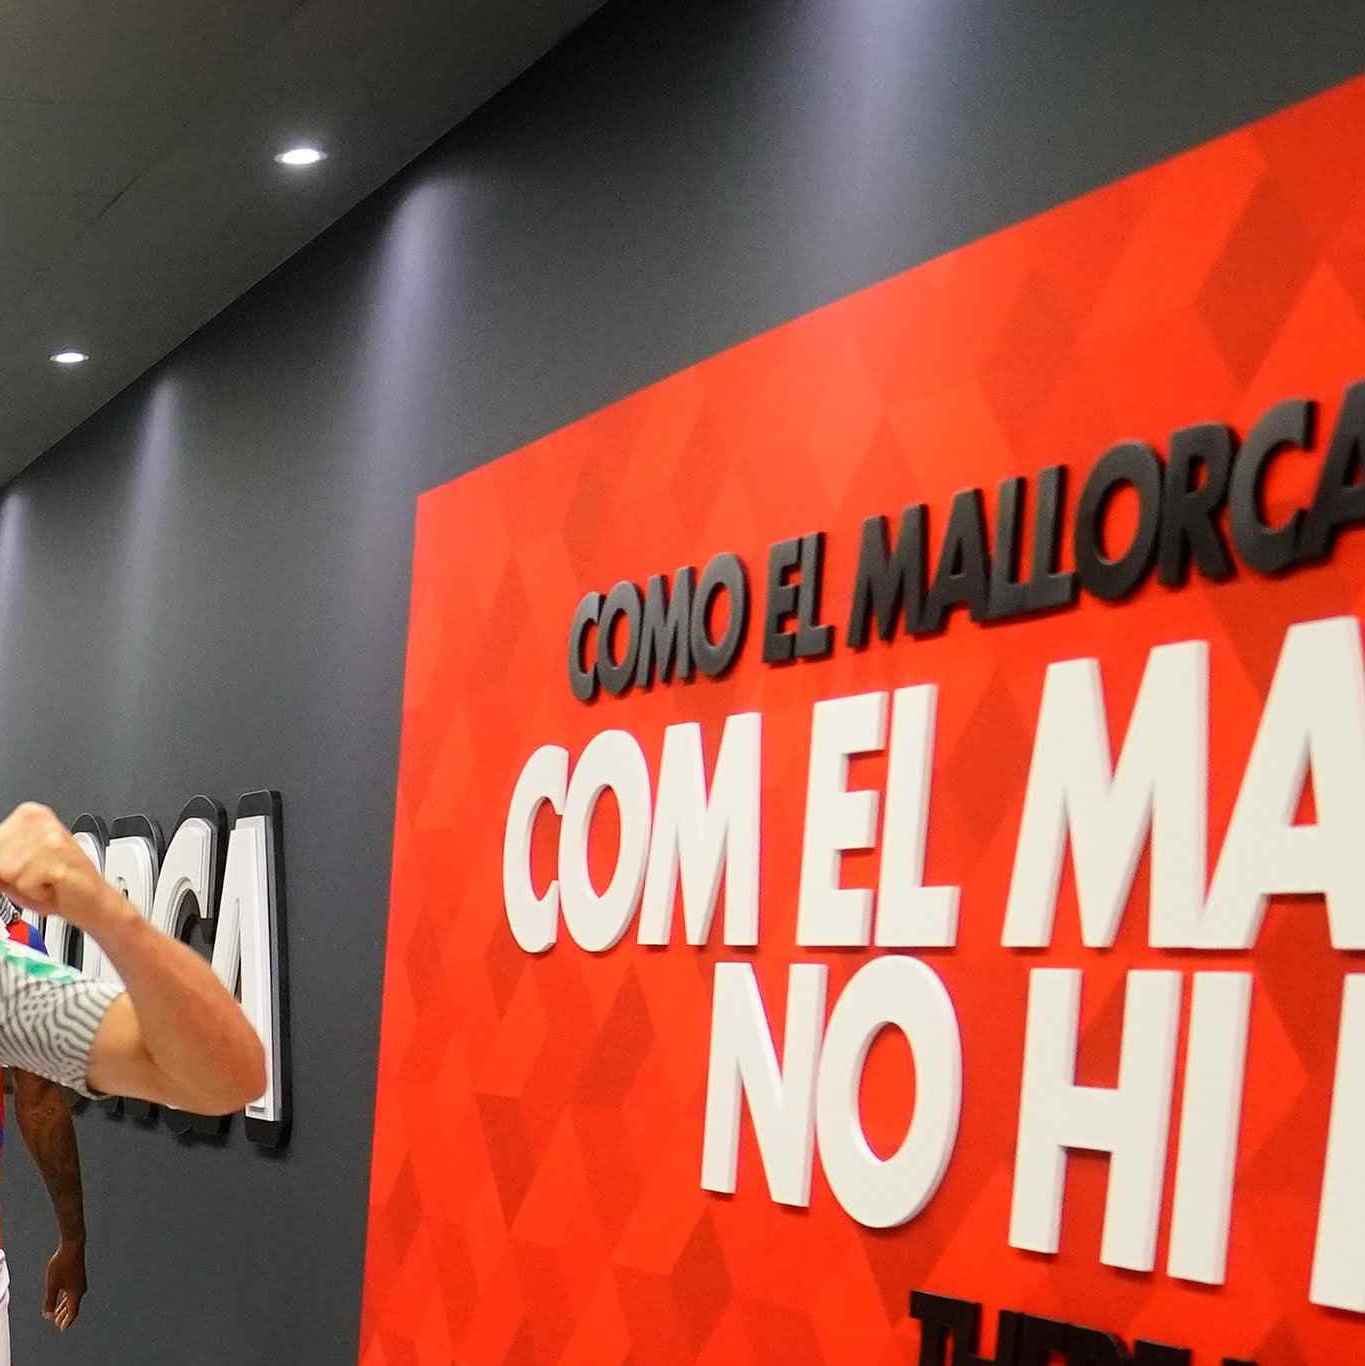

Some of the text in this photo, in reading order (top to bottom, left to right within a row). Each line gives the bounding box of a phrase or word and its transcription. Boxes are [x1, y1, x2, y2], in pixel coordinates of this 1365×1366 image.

[568, 378, 1365, 703] COMO EL MALLORCA
[503, 711, 762, 953] COM
[796, 683, 960, 949] EL
[700, 954, 963, 1229] NO
[1008, 968, 1254, 1286] HI
